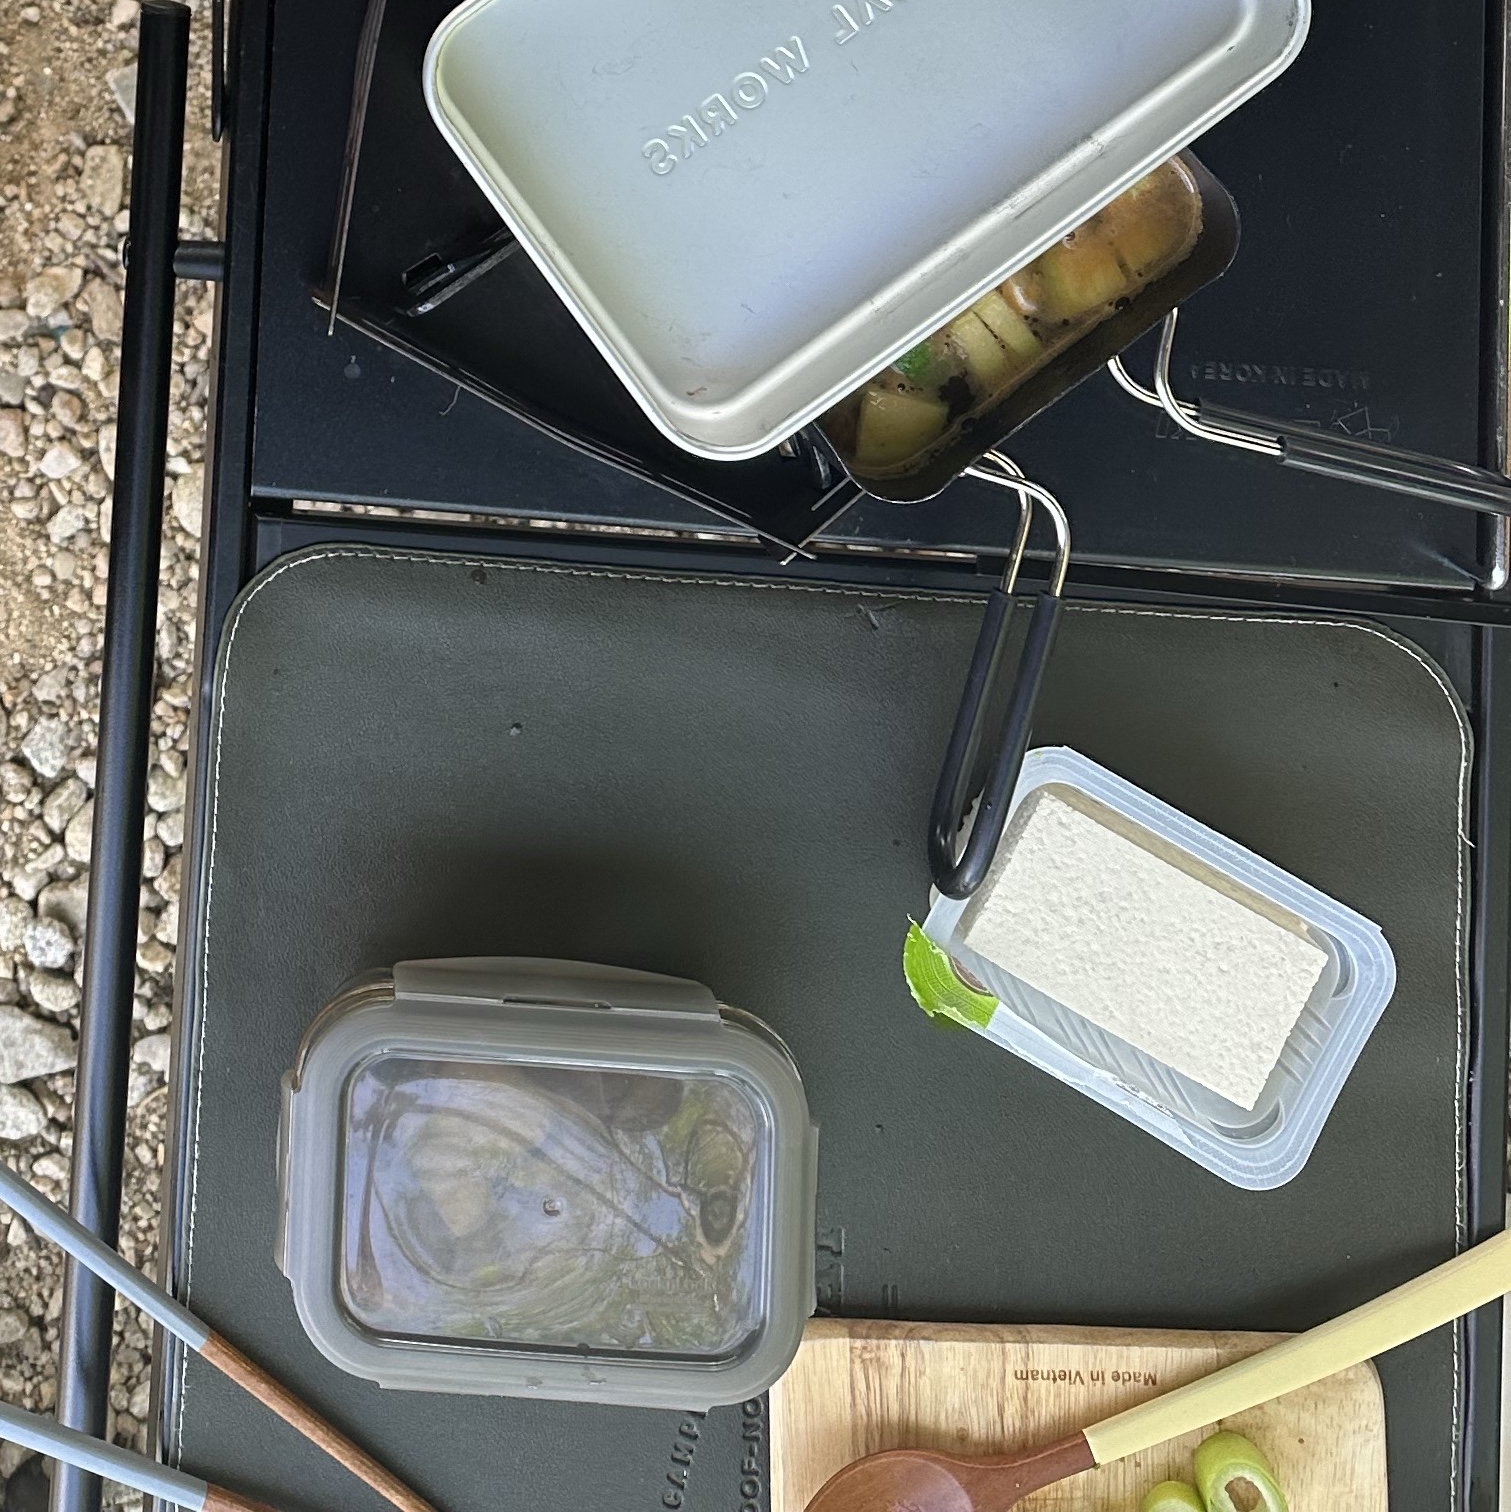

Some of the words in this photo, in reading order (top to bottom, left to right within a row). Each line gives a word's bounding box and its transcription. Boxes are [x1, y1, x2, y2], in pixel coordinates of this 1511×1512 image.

[1190, 361, 1267, 385] KOREA
[1014, 1368, 1085, 1385] Vietnam
[1091, 1369, 1107, 1385] in
[1111, 1369, 1158, 1387] Made
[661, 1410, 707, 1510] CAMP
